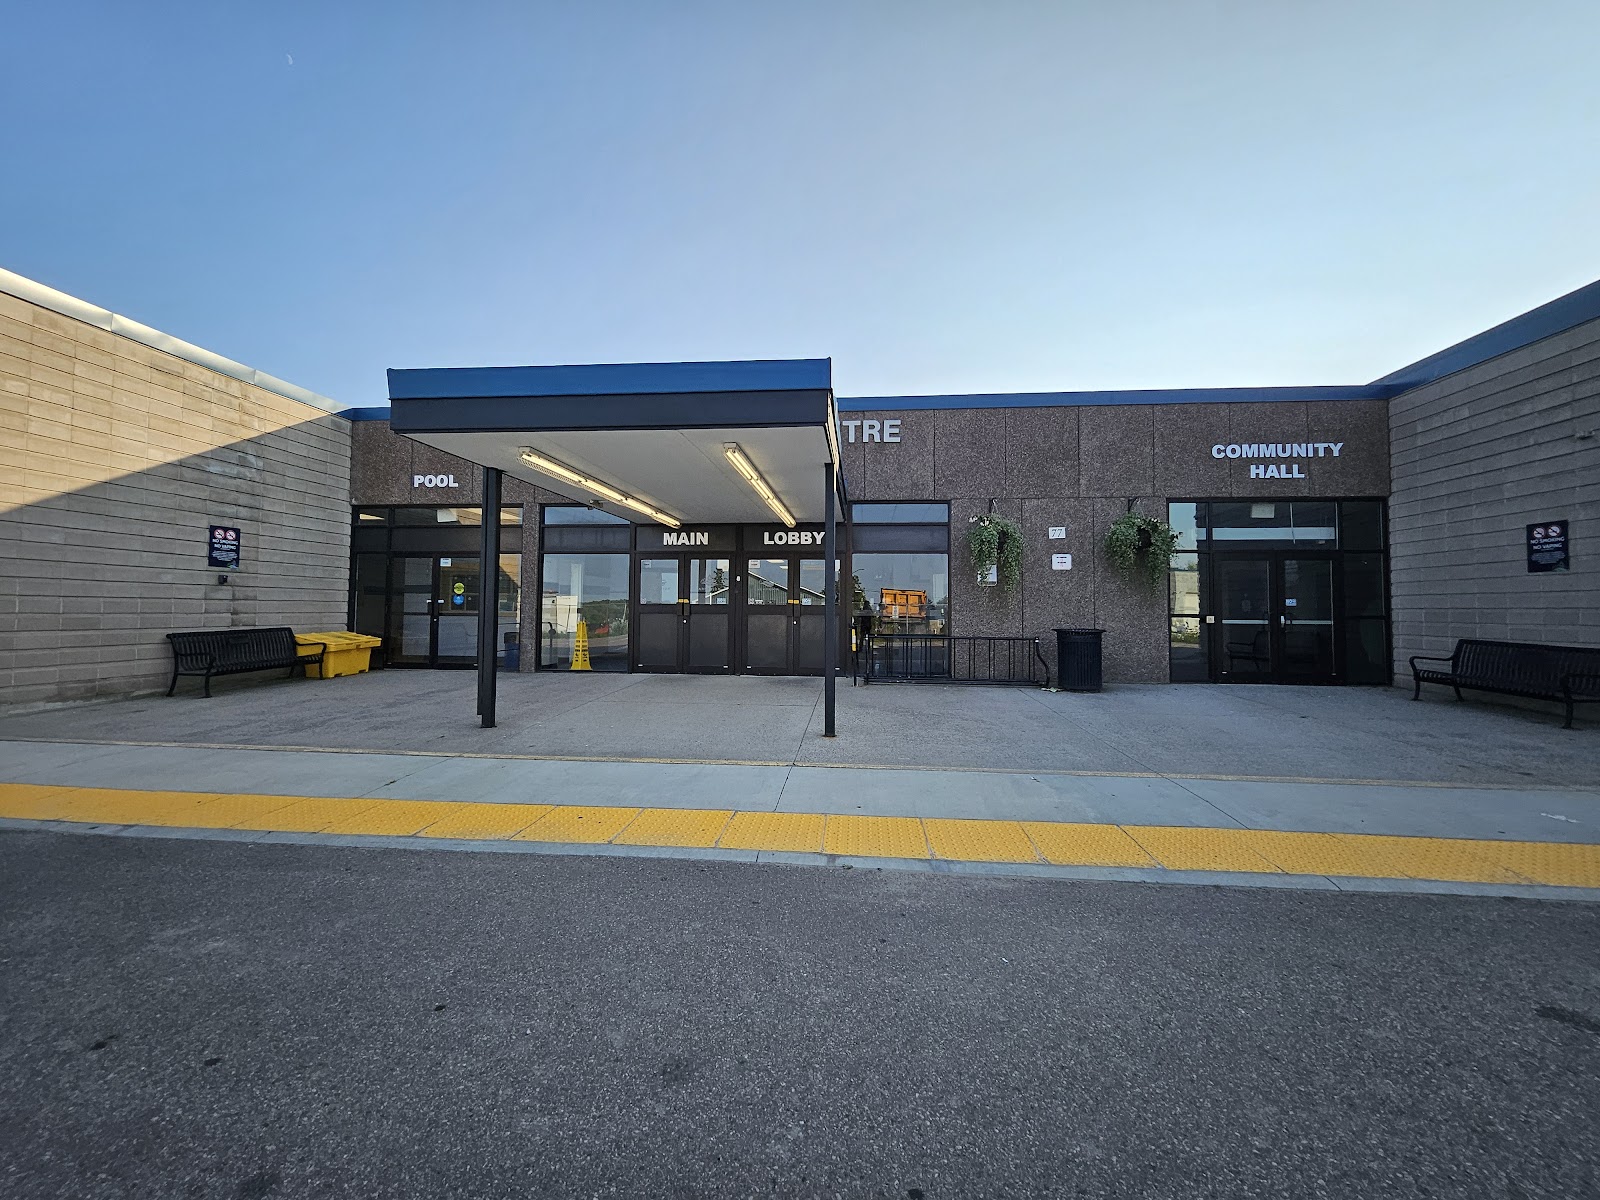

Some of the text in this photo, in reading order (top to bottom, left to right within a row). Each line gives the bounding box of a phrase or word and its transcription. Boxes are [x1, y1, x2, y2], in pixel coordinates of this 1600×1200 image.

[1211, 442, 1343, 458] COMMUNITY
[1250, 464, 1305, 479] HALL
[413, 474, 459, 488] POOL
[663, 531, 825, 546] MAIN LOBBY
[1052, 528, 1063, 538] 77
[1539, 536, 1565, 544] SMOKING
